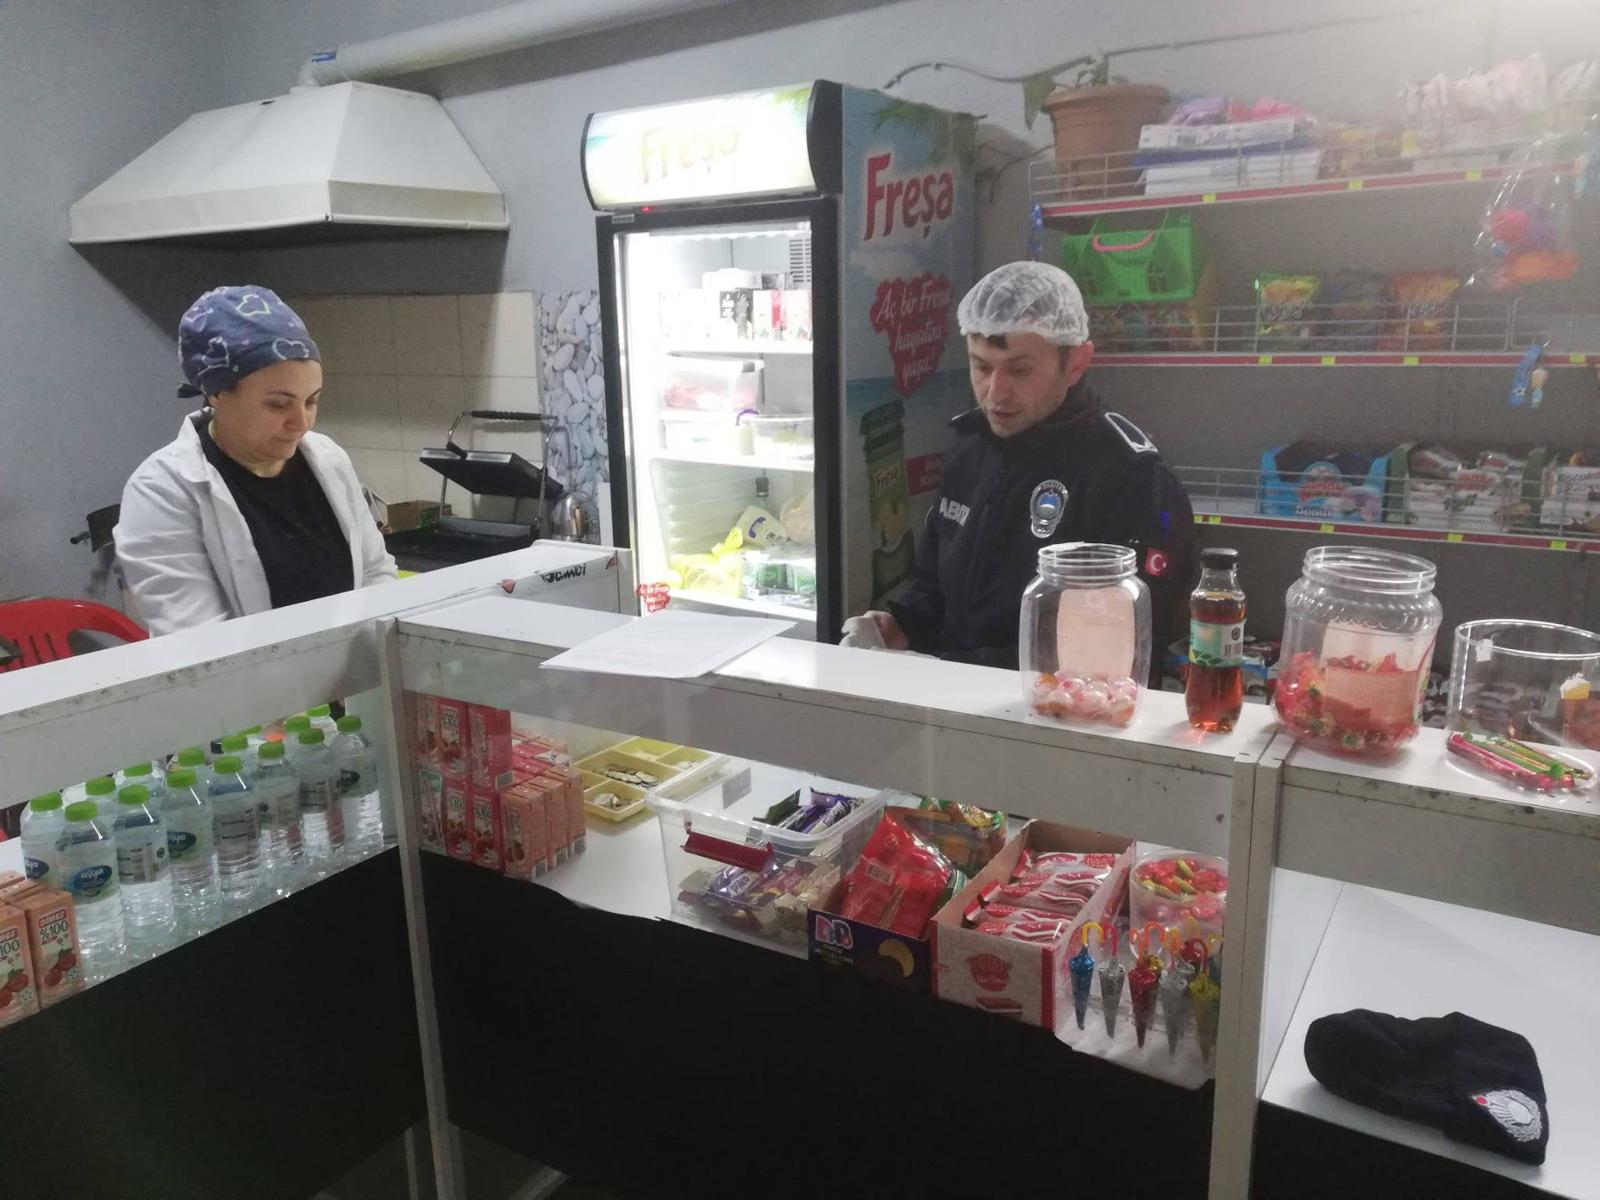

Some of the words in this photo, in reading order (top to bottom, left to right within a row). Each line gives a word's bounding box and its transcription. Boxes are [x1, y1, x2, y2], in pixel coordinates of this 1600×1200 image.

[862, 151, 954, 241] Freşa
[40, 920, 69, 940] %100
[0, 939, 20, 955] 100
